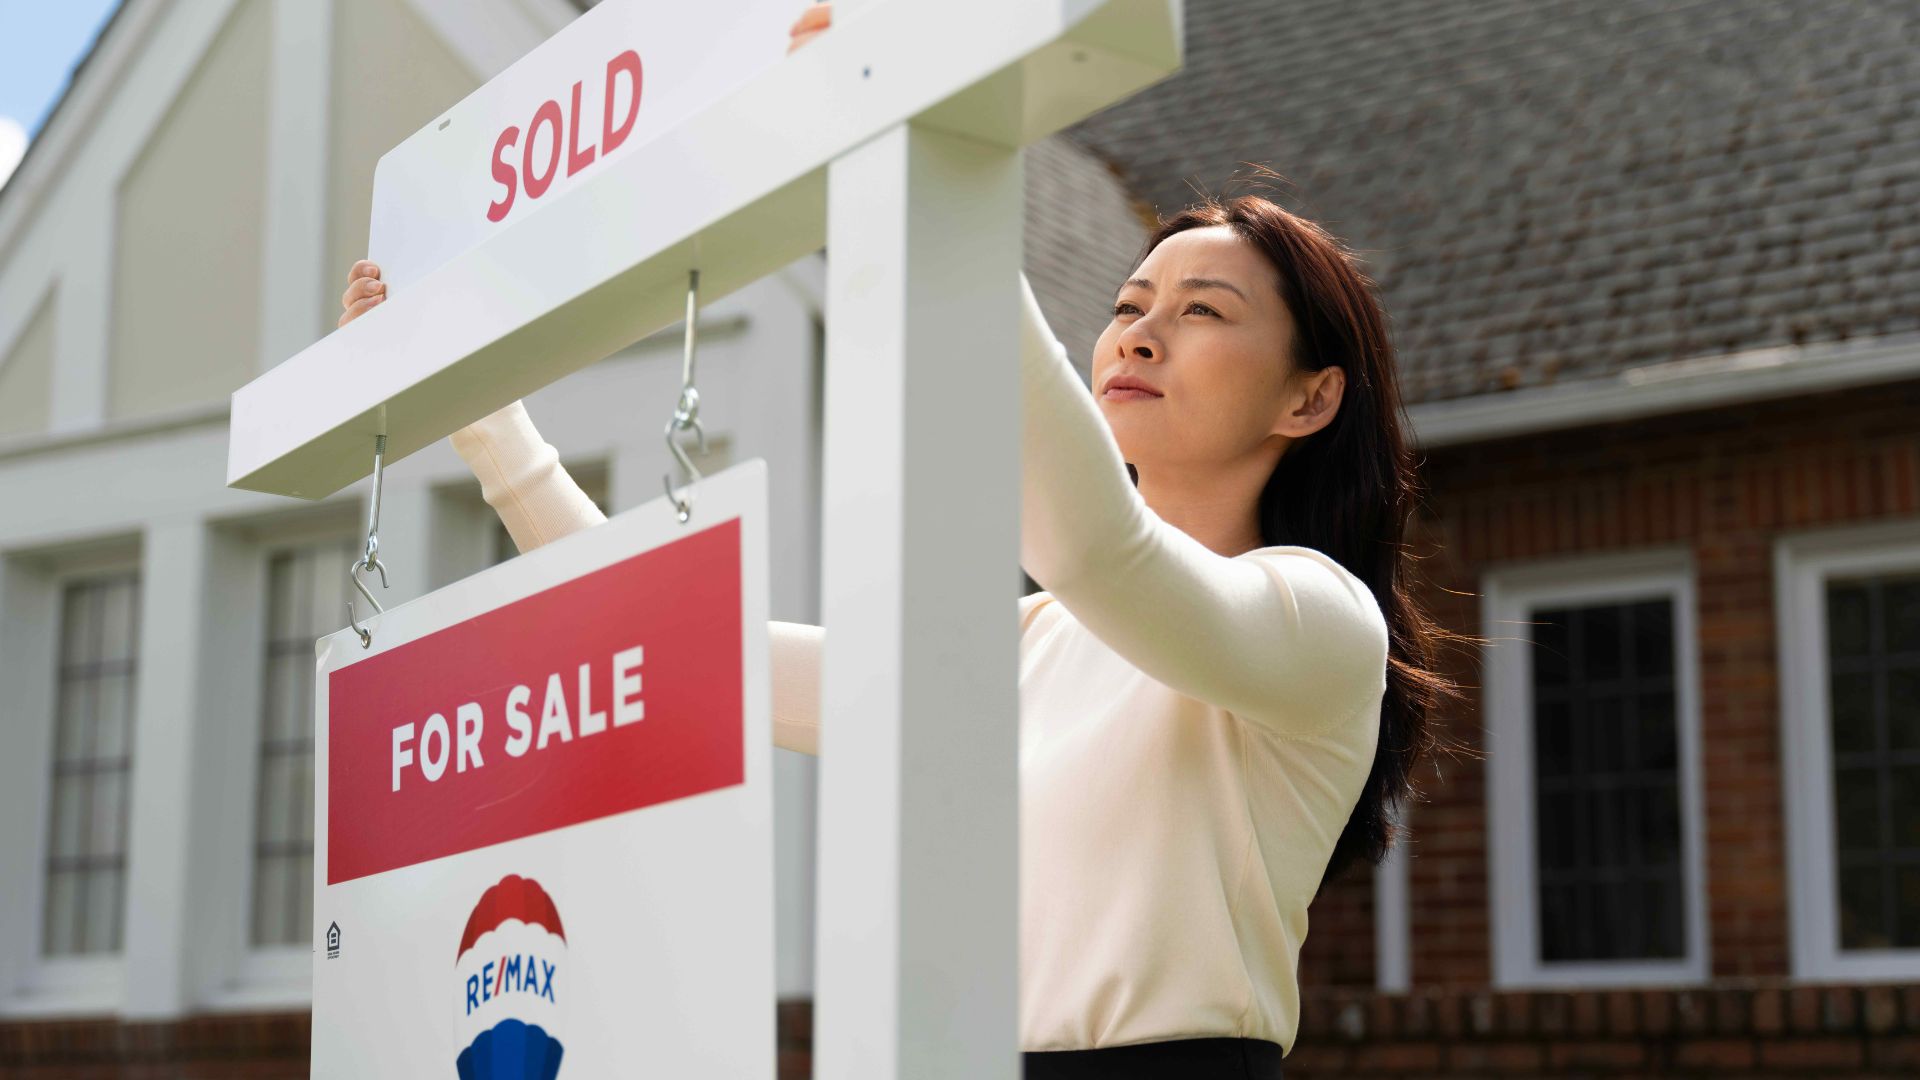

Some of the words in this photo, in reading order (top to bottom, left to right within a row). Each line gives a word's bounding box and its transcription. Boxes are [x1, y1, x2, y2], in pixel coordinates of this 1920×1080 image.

[487, 49, 643, 223] SOLD
[392, 702, 485, 792] FOR
[504, 645, 645, 758] SALE
[466, 954, 556, 1016] RE/MAX
